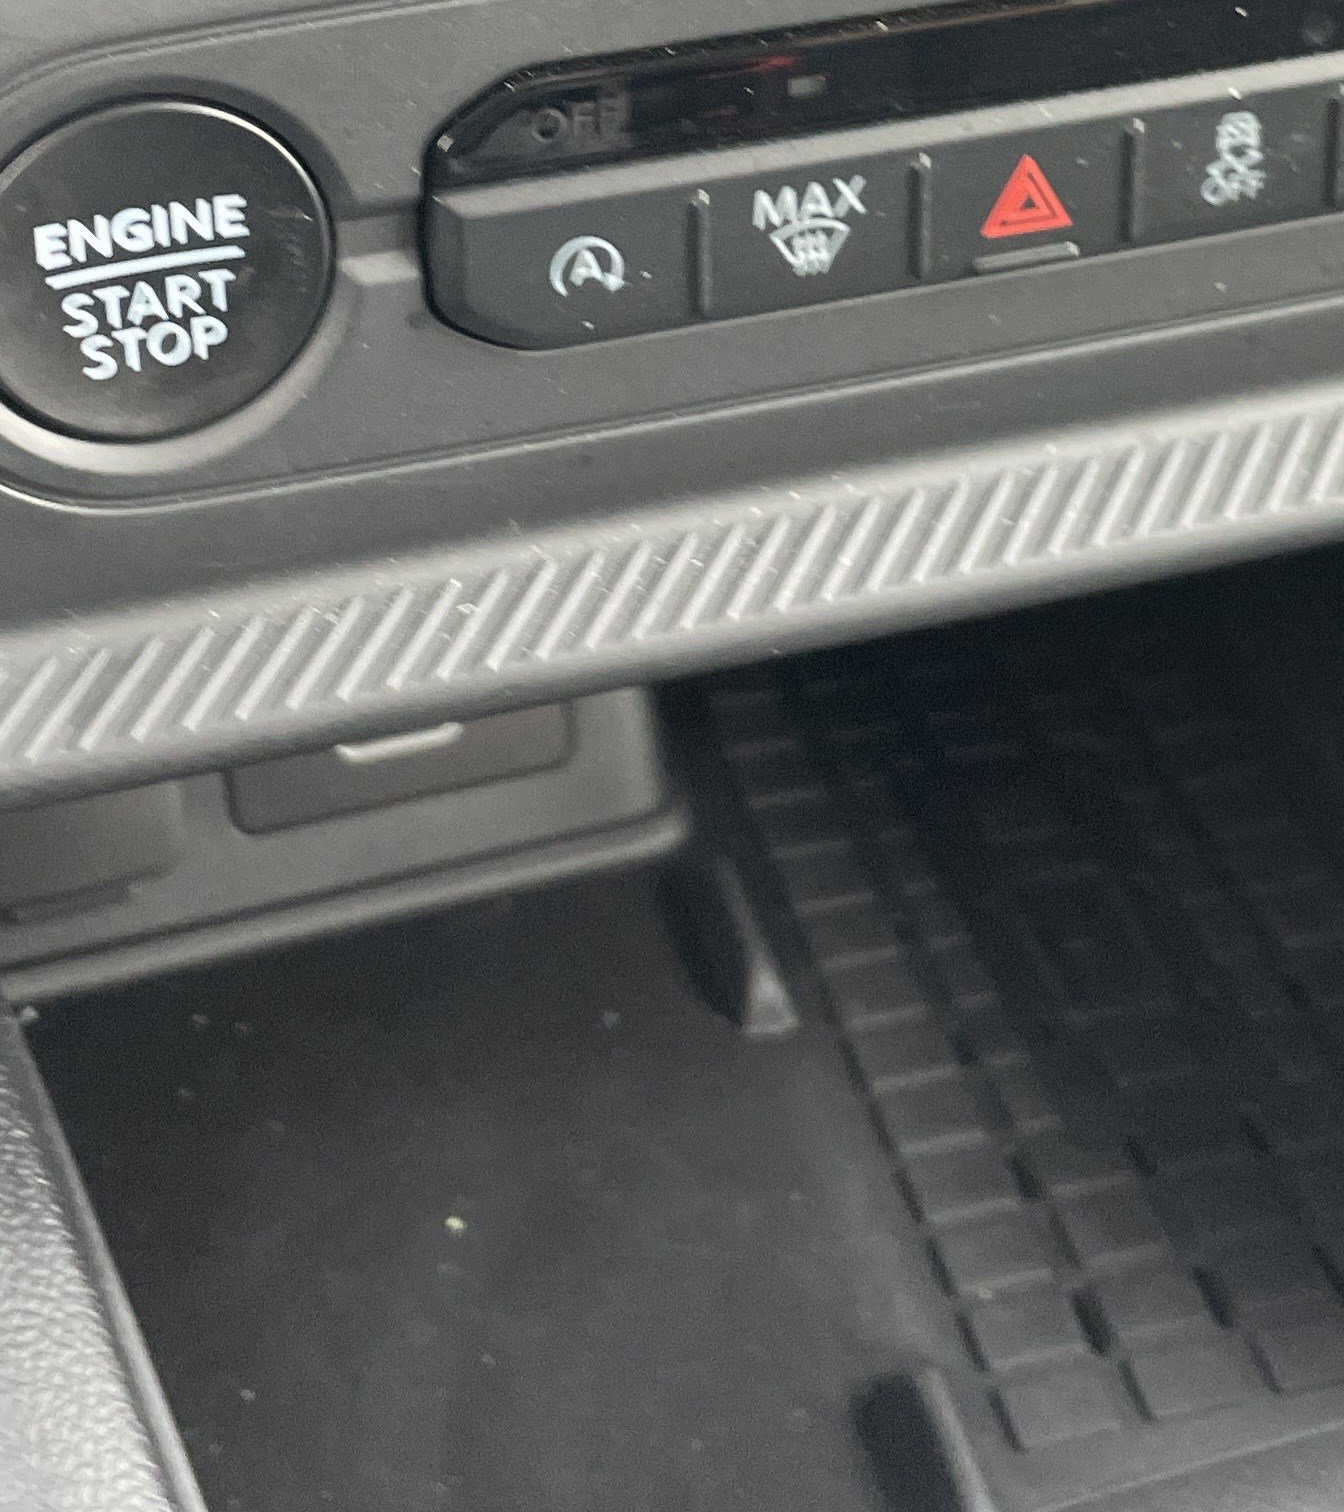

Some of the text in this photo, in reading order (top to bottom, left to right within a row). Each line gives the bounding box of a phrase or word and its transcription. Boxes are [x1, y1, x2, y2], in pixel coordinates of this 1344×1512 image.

[531, 99, 630, 145] OFF
[33, 192, 251, 271] ENGINE
[752, 174, 867, 232] MAX
[60, 267, 238, 339] START
[79, 314, 229, 381] STOP
